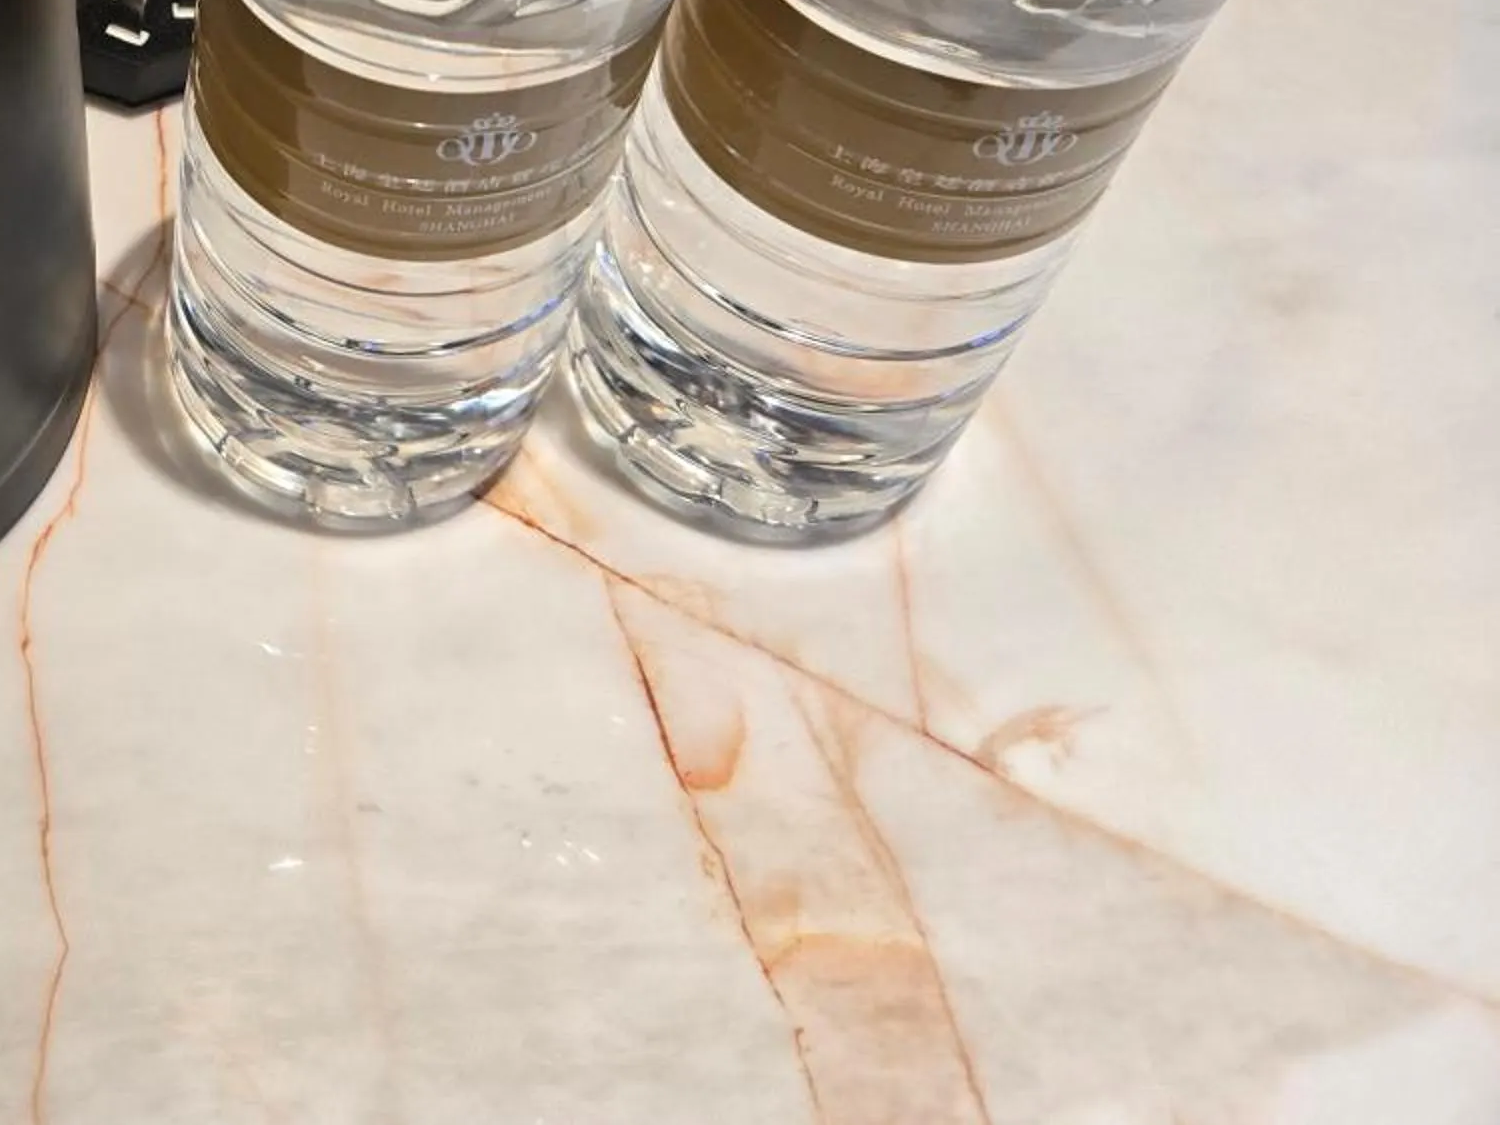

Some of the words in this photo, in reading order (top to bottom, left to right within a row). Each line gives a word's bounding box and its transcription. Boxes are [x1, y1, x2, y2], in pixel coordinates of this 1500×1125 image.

[320, 180, 370, 207] Royal
[381, 198, 432, 217] Hotel
[444, 186, 552, 217] Management
[830, 174, 884, 203] Royal
[897, 195, 952, 216] Hotel
[418, 212, 515, 233] SHANGHAI
